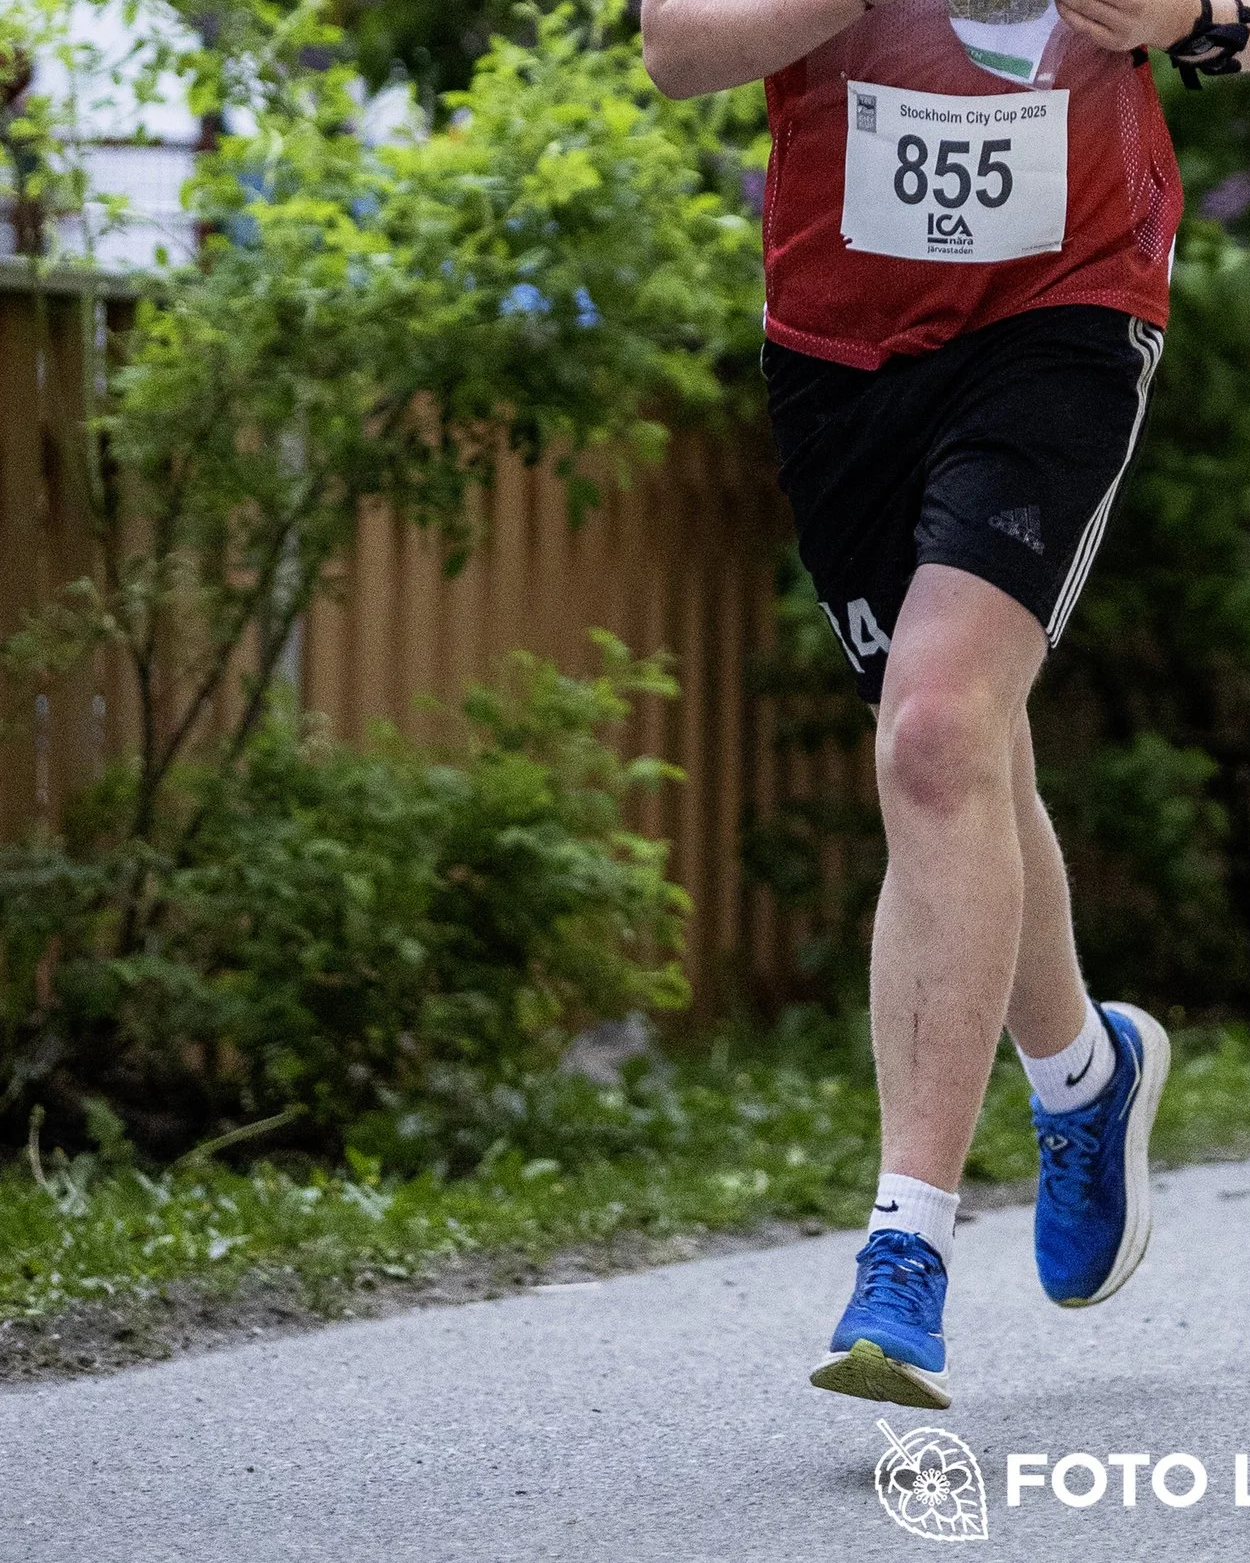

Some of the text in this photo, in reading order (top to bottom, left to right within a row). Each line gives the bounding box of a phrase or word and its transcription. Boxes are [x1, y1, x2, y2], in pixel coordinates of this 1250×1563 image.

[900, 104, 1047, 126] Stockholm City Cup 2025
[894, 134, 1013, 209] 855
[927, 213, 973, 237] ICA
